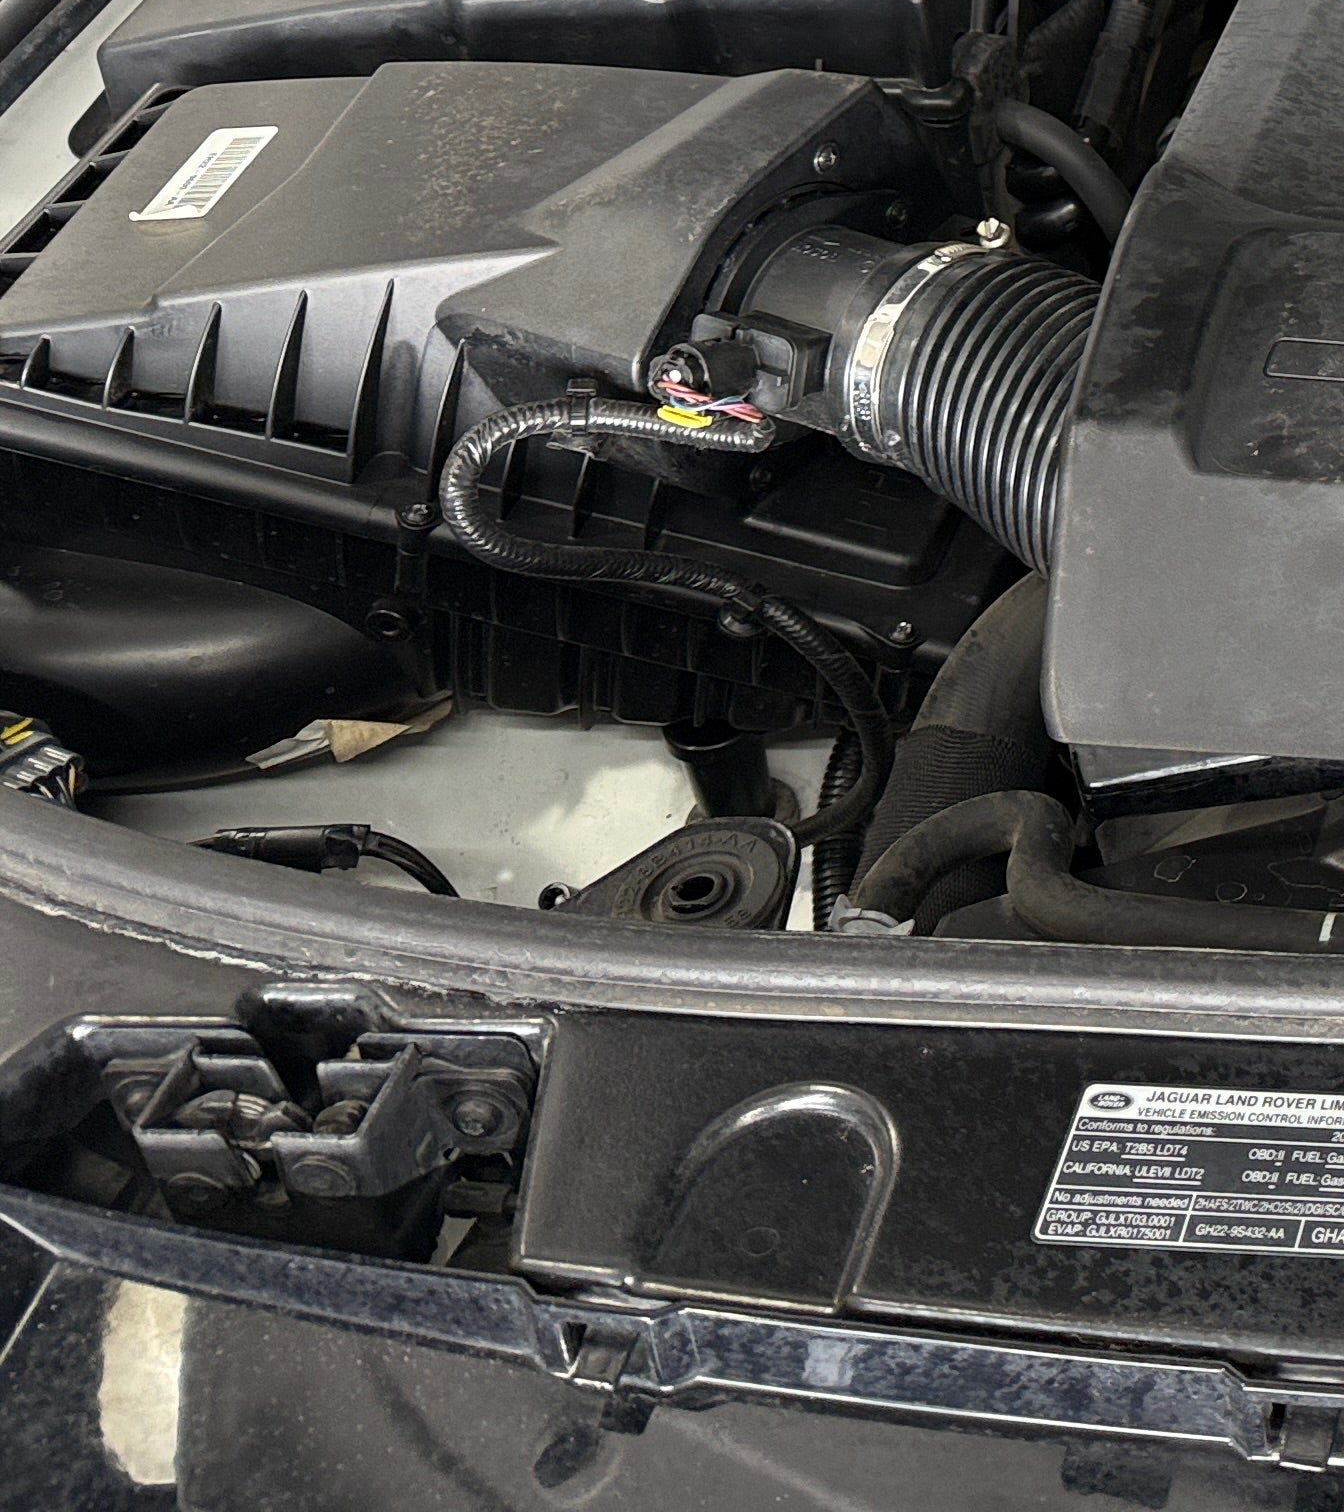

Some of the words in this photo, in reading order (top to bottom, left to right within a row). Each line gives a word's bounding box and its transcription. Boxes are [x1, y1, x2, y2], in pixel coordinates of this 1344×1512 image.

[1146, 1091, 1211, 1105] JAGUAR
[1215, 1094, 1259, 1107] LAND
[1262, 1096, 1317, 1109] ROVER
[1137, 1107, 1186, 1119] VEHICLE
[1189, 1110, 1245, 1122] EMISSION
[1247, 1112, 1303, 1125] CONTROL
[1078, 1118, 1134, 1132] Conforms
[1136, 1122, 1148, 1133] to
[1071, 1139, 1091, 1151] US
[1155, 1144, 1188, 1156] LDT4
[1174, 1167, 1206, 1180] LDT2
[1052, 1191, 1071, 1203] No
[1071, 1192, 1143, 1206] adjustments
[1143, 1197, 1190, 1209] needed
